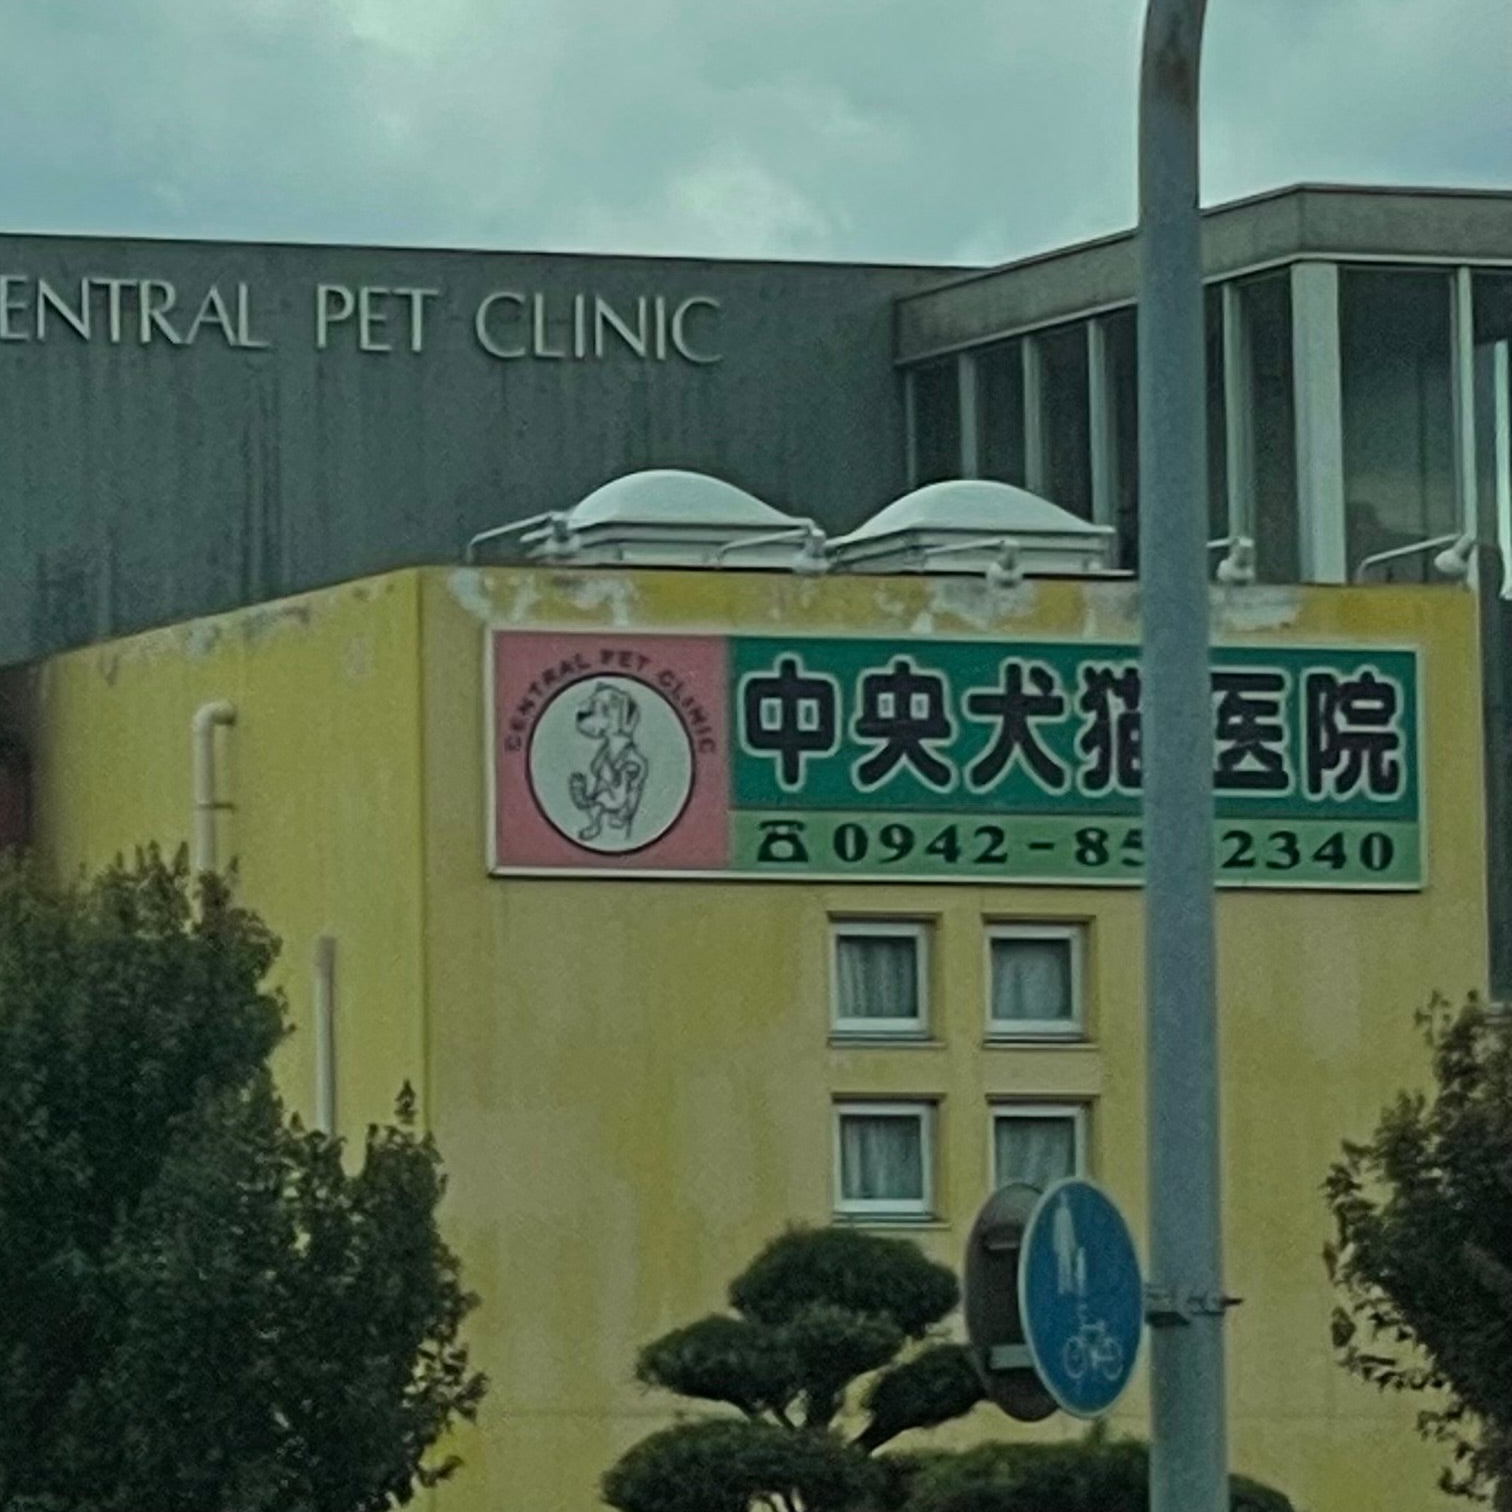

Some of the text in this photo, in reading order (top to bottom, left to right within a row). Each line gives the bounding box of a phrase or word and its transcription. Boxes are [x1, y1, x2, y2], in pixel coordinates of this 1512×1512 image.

[316, 283, 438, 353] PET
[475, 291, 724, 364] CLINIC
[504, 648, 717, 754] CENTRAL PET CLINIC
[833, 822, 1396, 872] 0942-852340
